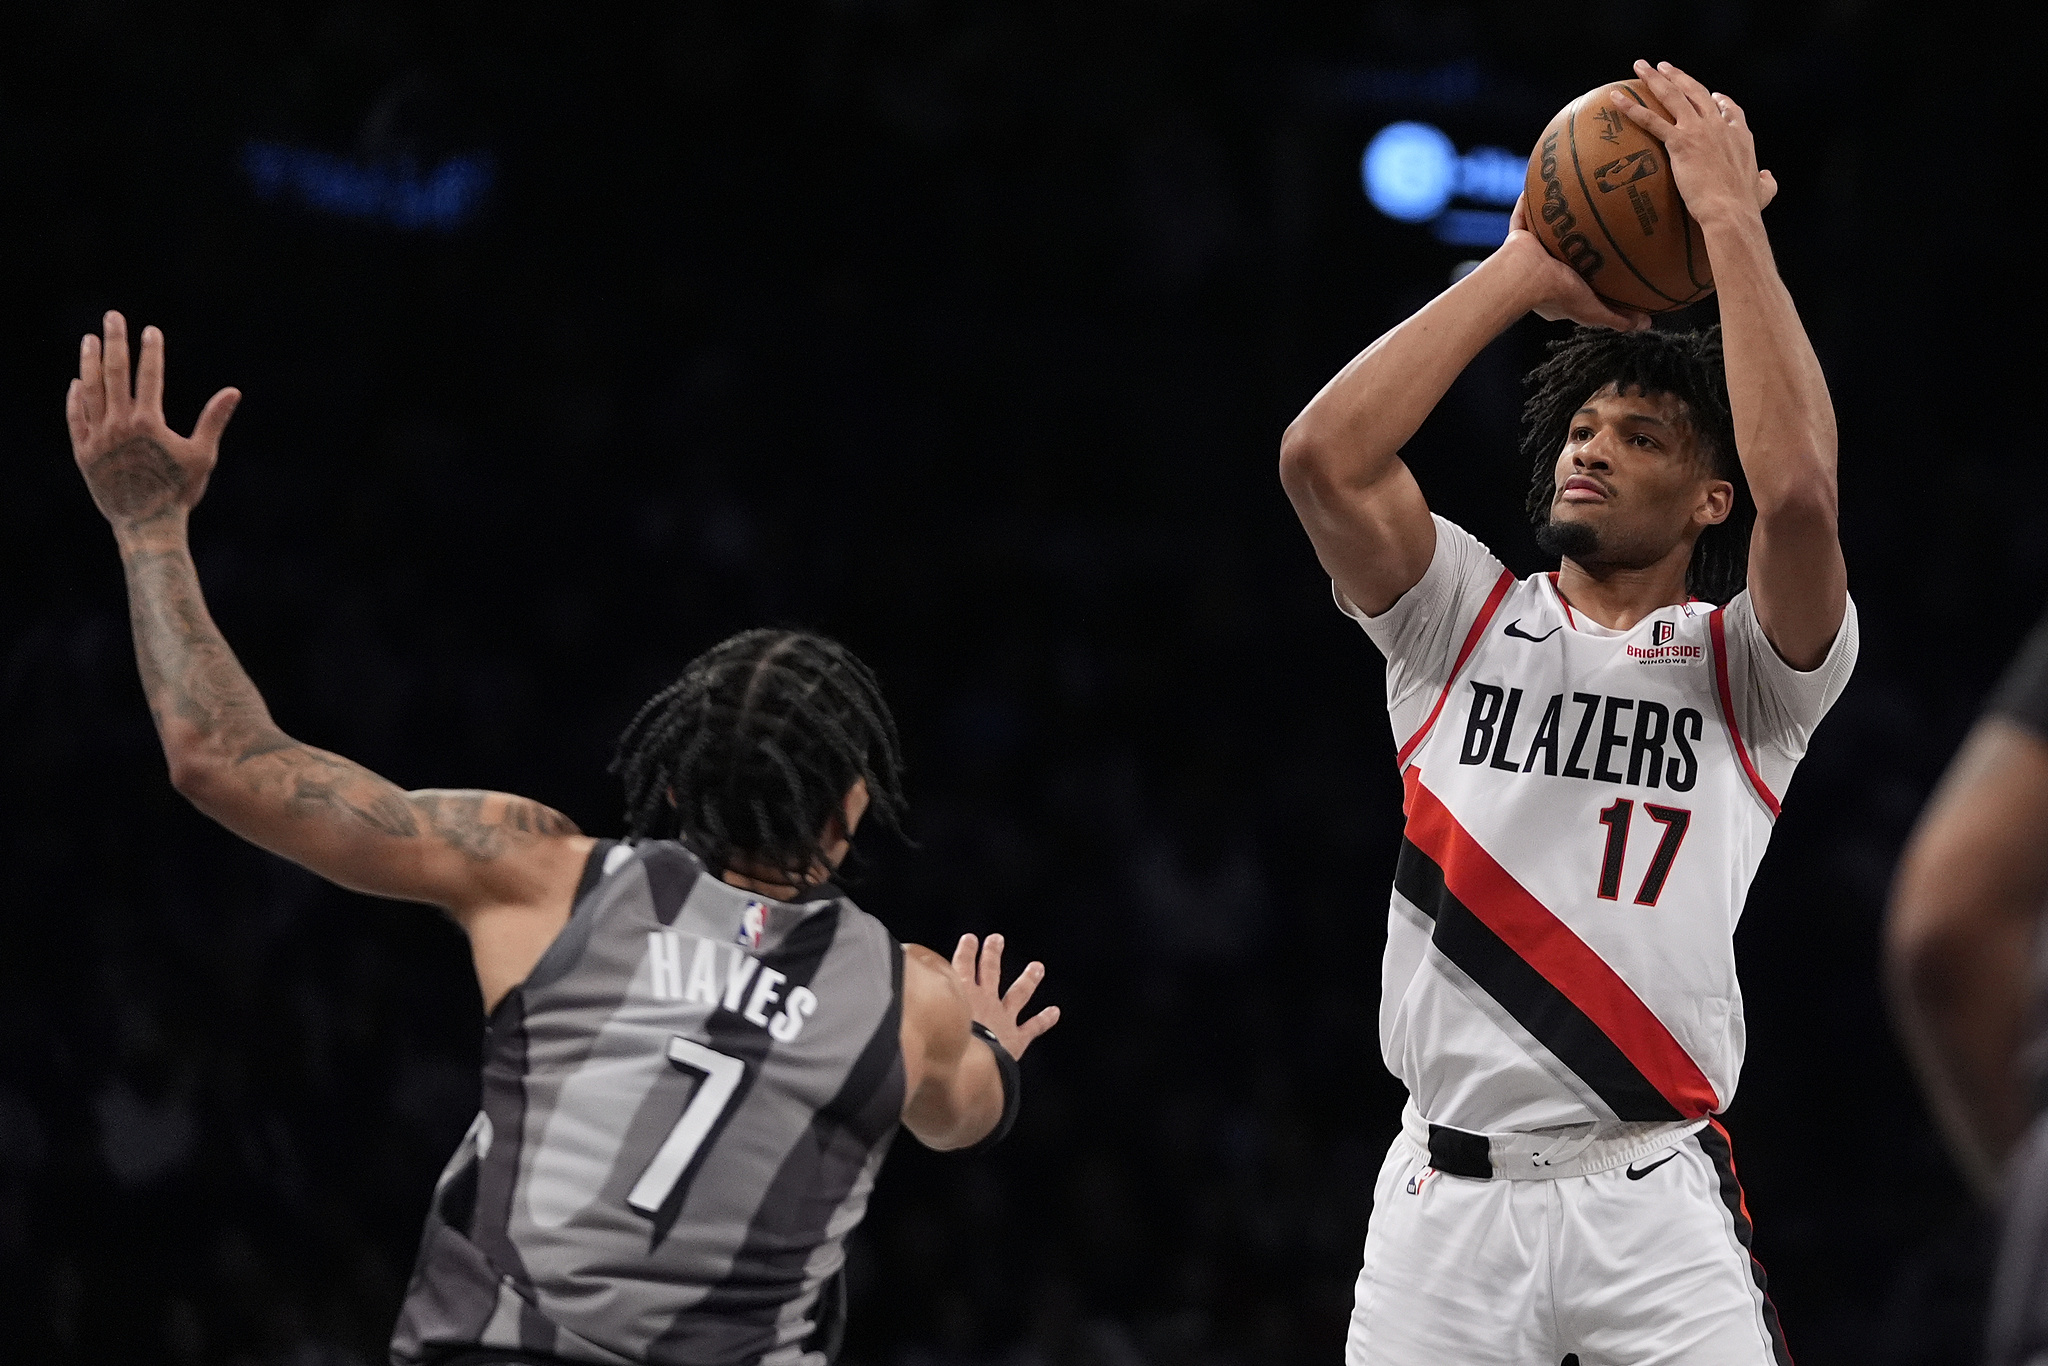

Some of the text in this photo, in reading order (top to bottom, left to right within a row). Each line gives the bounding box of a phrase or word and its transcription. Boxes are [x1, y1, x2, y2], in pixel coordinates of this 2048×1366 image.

[1541, 130, 1605, 282] Wilson
[1626, 644, 1701, 659] BRIGHTSIDE
[1459, 680, 1704, 793] BLAZERS
[1597, 797, 1692, 907] 17
[648, 931, 818, 1042] HAYES
[627, 1035, 746, 1214] 7
